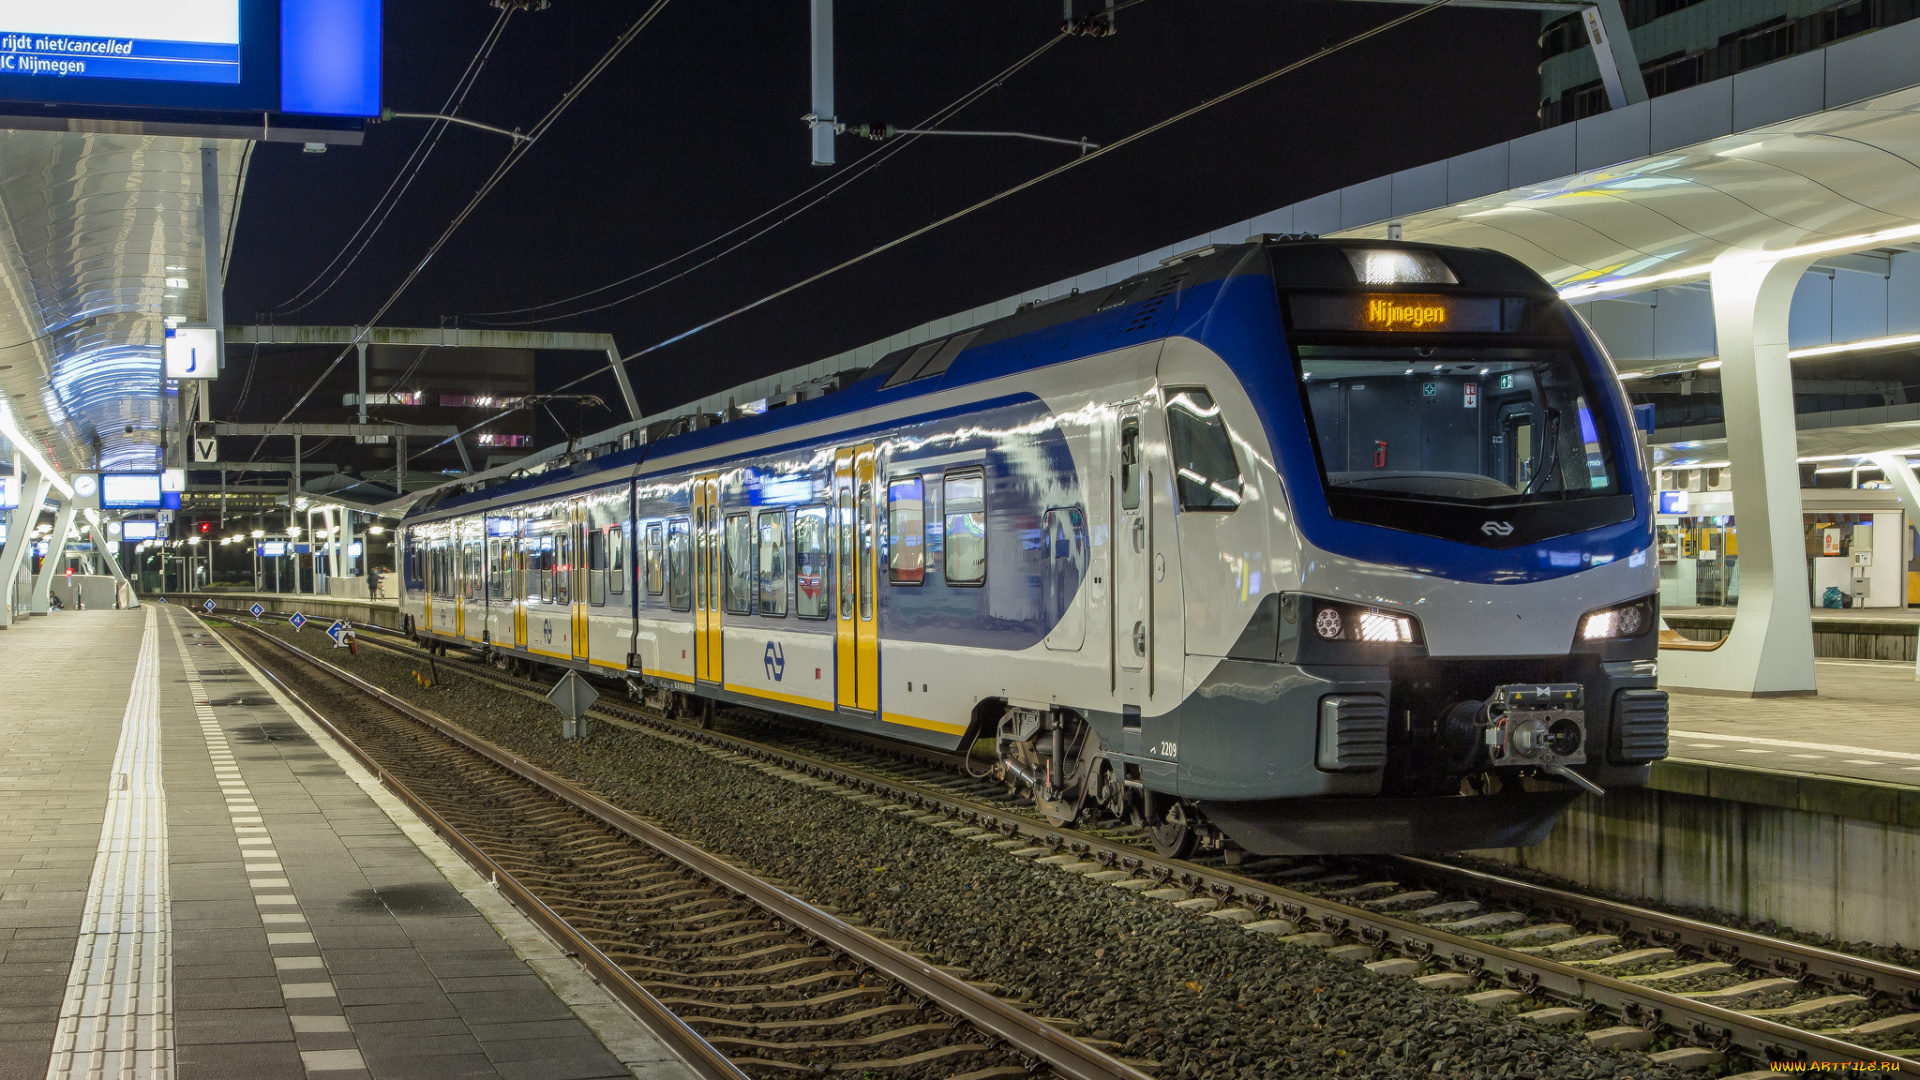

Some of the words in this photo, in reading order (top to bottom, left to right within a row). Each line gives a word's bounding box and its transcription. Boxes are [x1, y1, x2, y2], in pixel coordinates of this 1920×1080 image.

[2, 35, 32, 52] rijdt
[36, 36, 133, 55] niet/cancelled
[1, 55, 15, 69] IC
[19, 56, 85, 75] Nijmegen
[1369, 300, 1445, 327] Nijmegen
[186, 348, 196, 372] J
[197, 441, 214, 460] V
[161, 514, 169, 522] H
[254, 606, 260, 614] 6
[293, 616, 301, 624] 4
[1161, 741, 1177, 757] 2209
